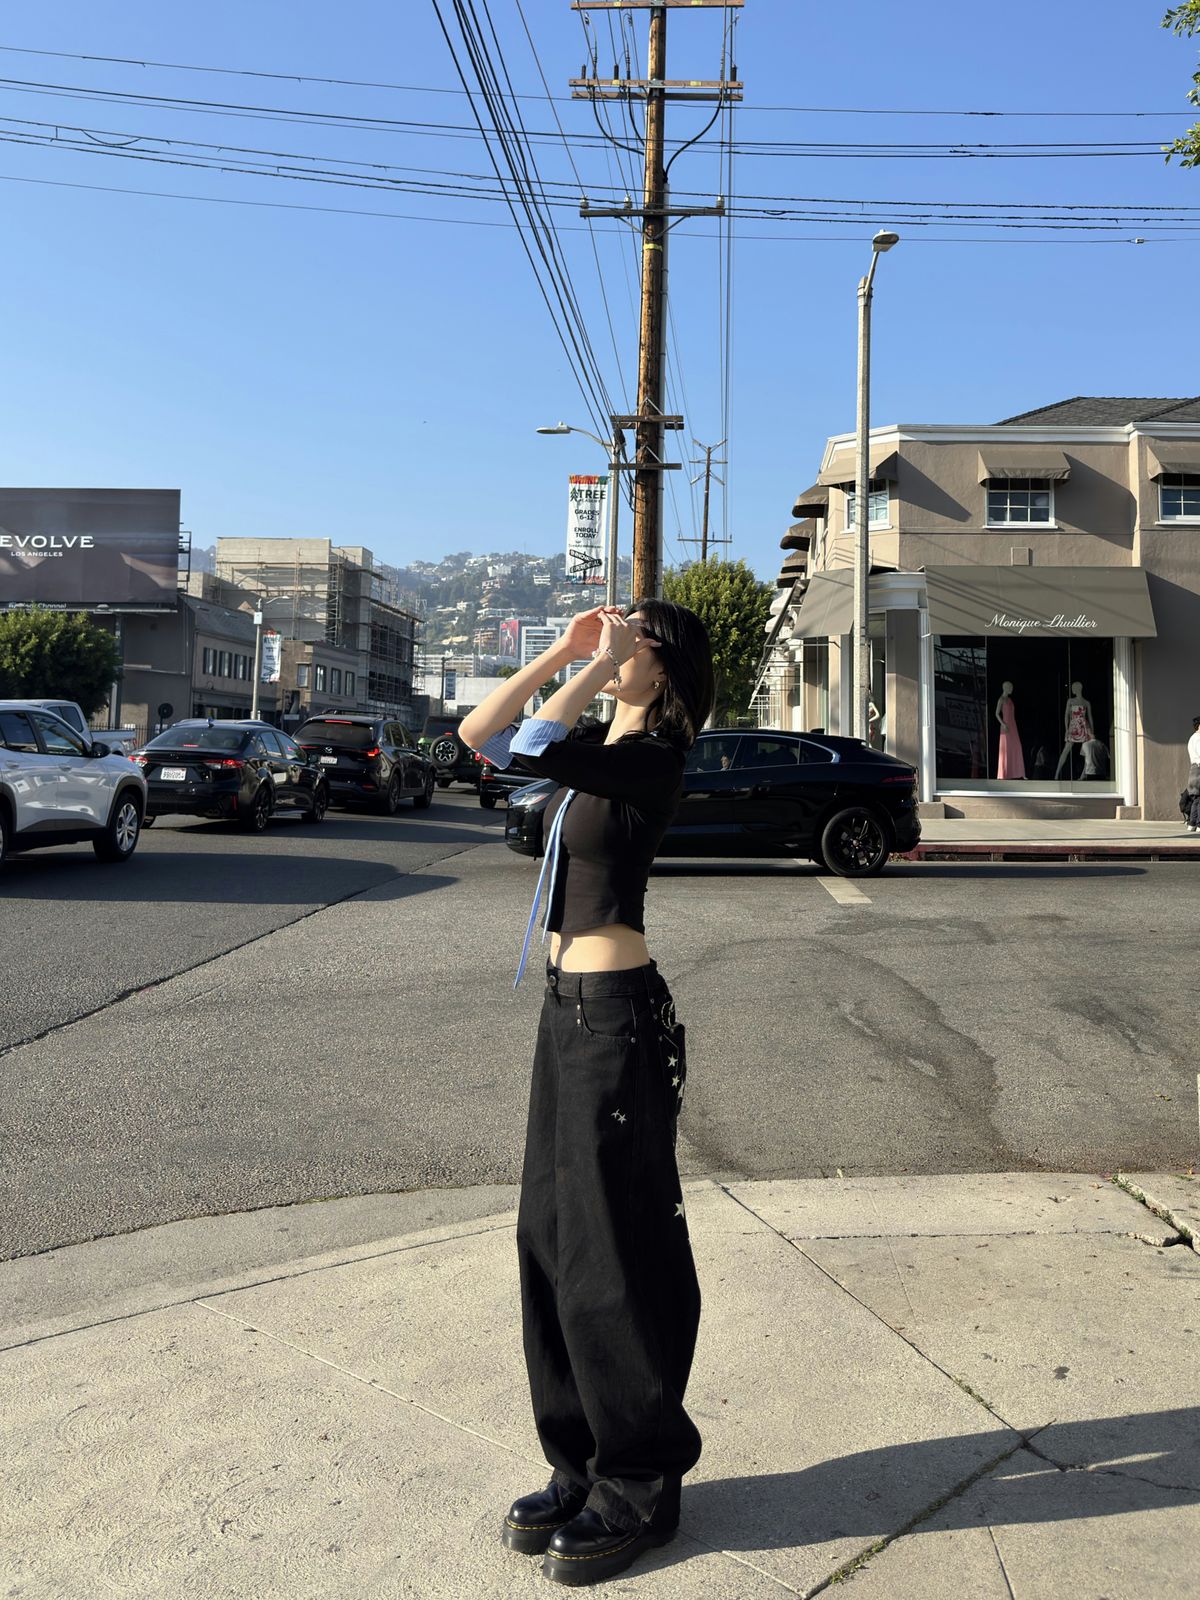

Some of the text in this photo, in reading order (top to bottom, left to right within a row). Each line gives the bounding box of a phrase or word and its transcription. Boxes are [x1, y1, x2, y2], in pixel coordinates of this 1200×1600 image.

[577, 489, 607, 500] TREE
[574, 526, 599, 534] ENROLL
[0, 535, 94, 549] EVOLVE
[984, 613, 1098, 634] Monique Lhuillier
